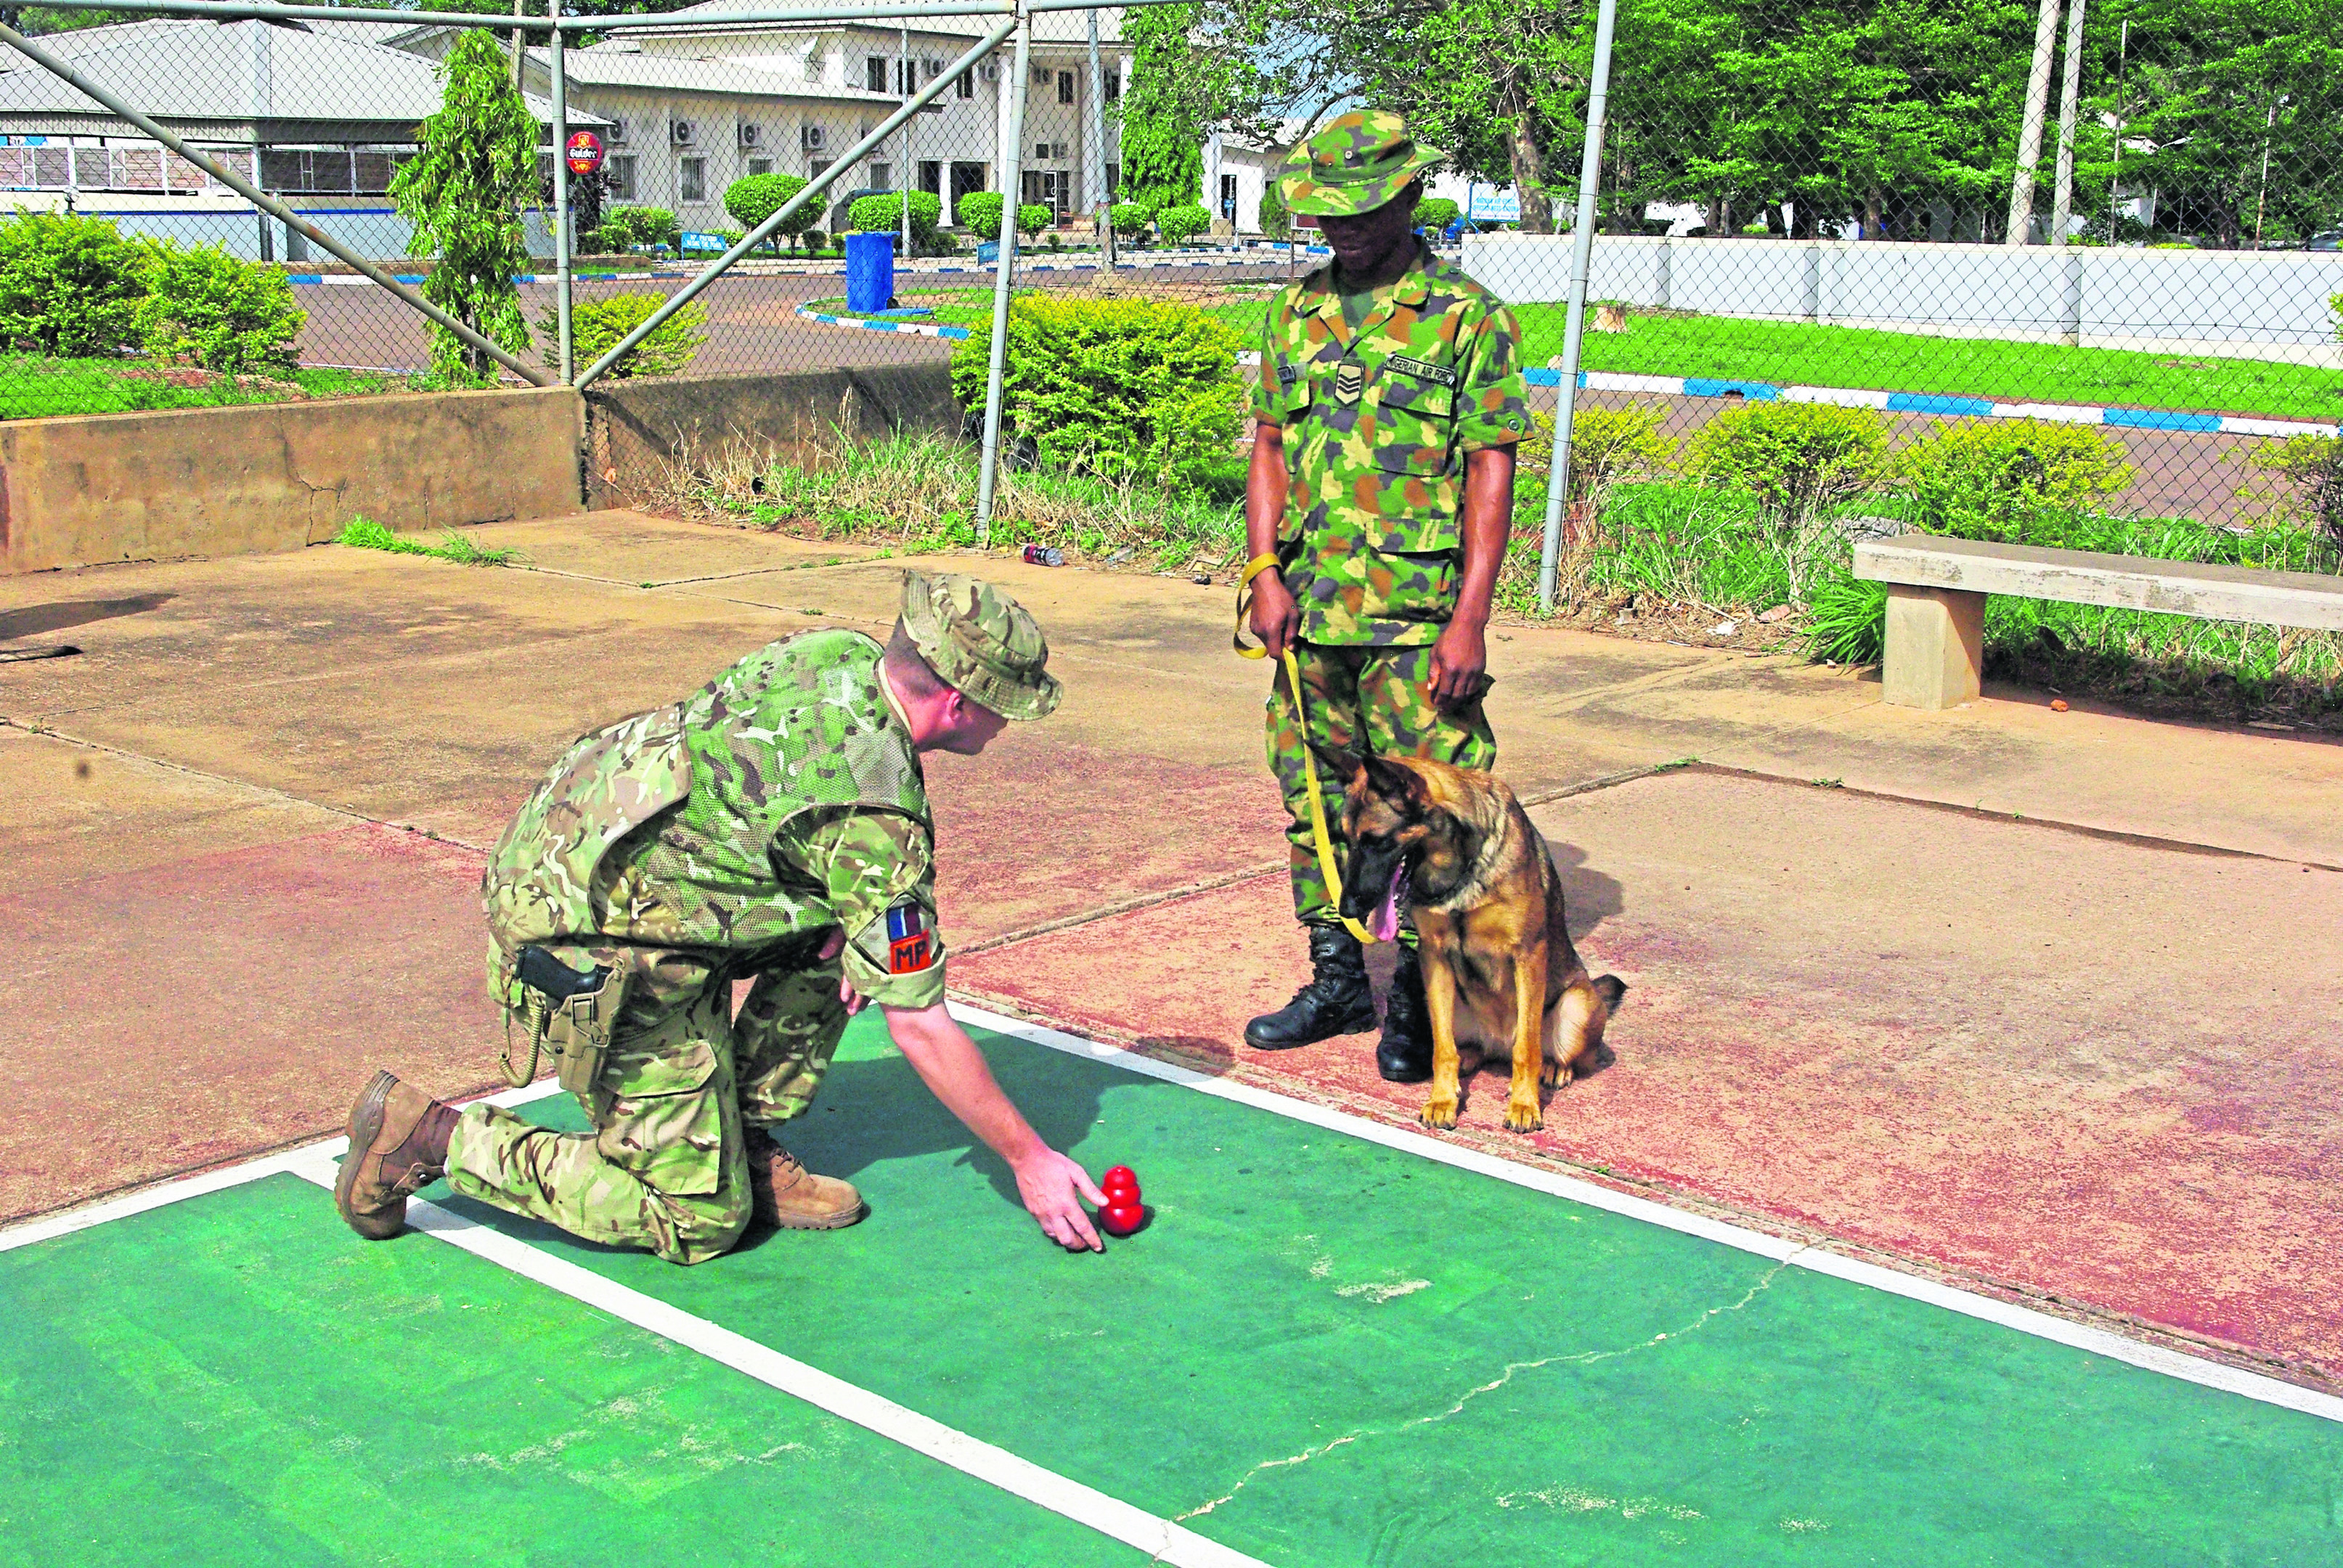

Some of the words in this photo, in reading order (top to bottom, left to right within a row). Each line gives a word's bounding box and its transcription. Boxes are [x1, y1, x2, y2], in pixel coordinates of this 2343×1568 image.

[569, 148, 598, 158] Gulder
[1386, 357, 1419, 374] NIGERIAN
[1421, 365, 1433, 376] AIR
[1435, 369, 1454, 382] FORC
[896, 940, 926, 970] MP
